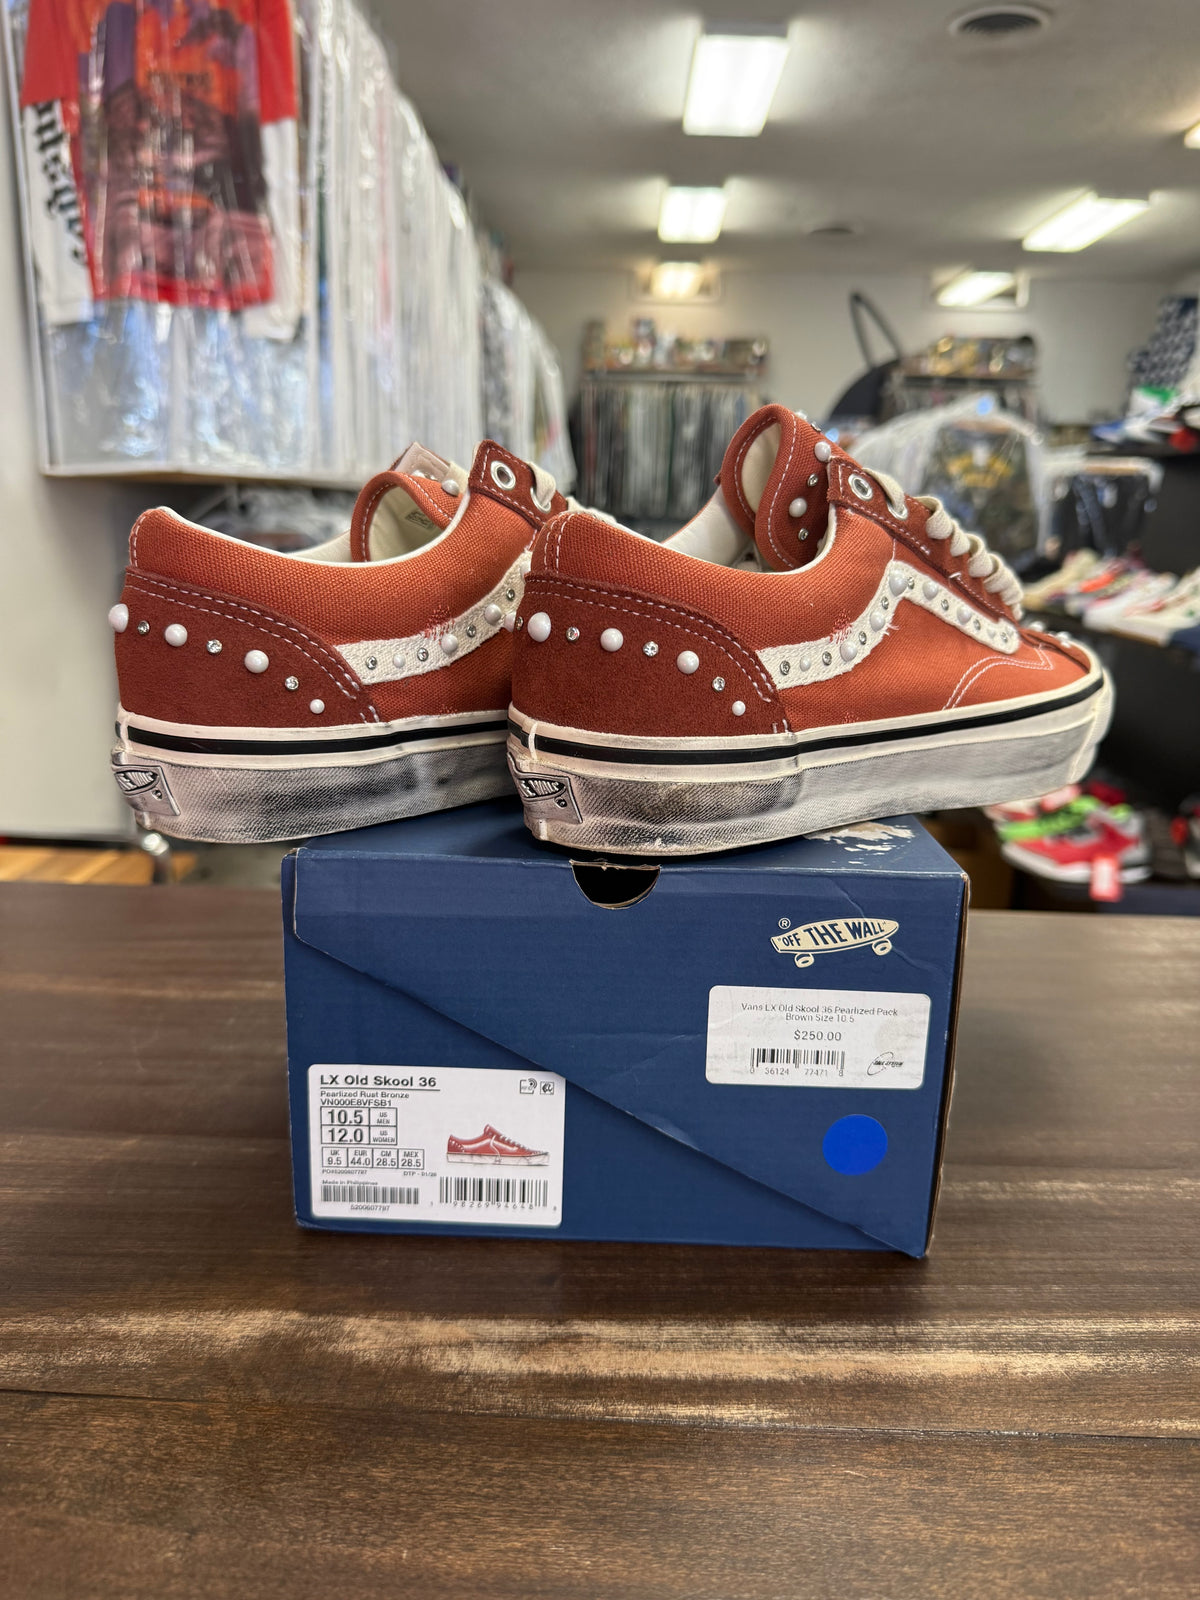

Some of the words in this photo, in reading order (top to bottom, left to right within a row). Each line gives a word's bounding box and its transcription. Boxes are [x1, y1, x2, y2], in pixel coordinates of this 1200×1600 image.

[803, 922, 848, 946] THE
[741, 1002, 763, 1011] Vans
[764, 1003, 776, 1012] LX
[778, 1004, 793, 1012] Old
[795, 1005, 820, 1013] Skool
[822, 1006, 832, 1014] 36
[834, 1006, 875, 1015] Pearlized
[876, 1008, 898, 1016] Pack
[786, 1013, 813, 1021] Brown
[815, 1014, 834, 1022] Size
[794, 1029, 842, 1041] $250.00
[765, 1067, 789, 1076] 36124
[804, 1068, 828, 1076] 77471
[838, 1069, 844, 1077] 8
[320, 1074, 339, 1085] LX
[344, 1074, 368, 1085] Old
[374, 1076, 413, 1087] Skool
[419, 1077, 436, 1087] 36
[381, 1091, 409, 1099] Bronze
[328, 1109, 363, 1124] 10.5
[328, 1128, 363, 1143] 12.0
[327, 1157, 342, 1165] 9.5
[350, 1157, 371, 1166] 44.0
[376, 1158, 396, 1167] 28.5
[401, 1159, 421, 1167] 28.5
